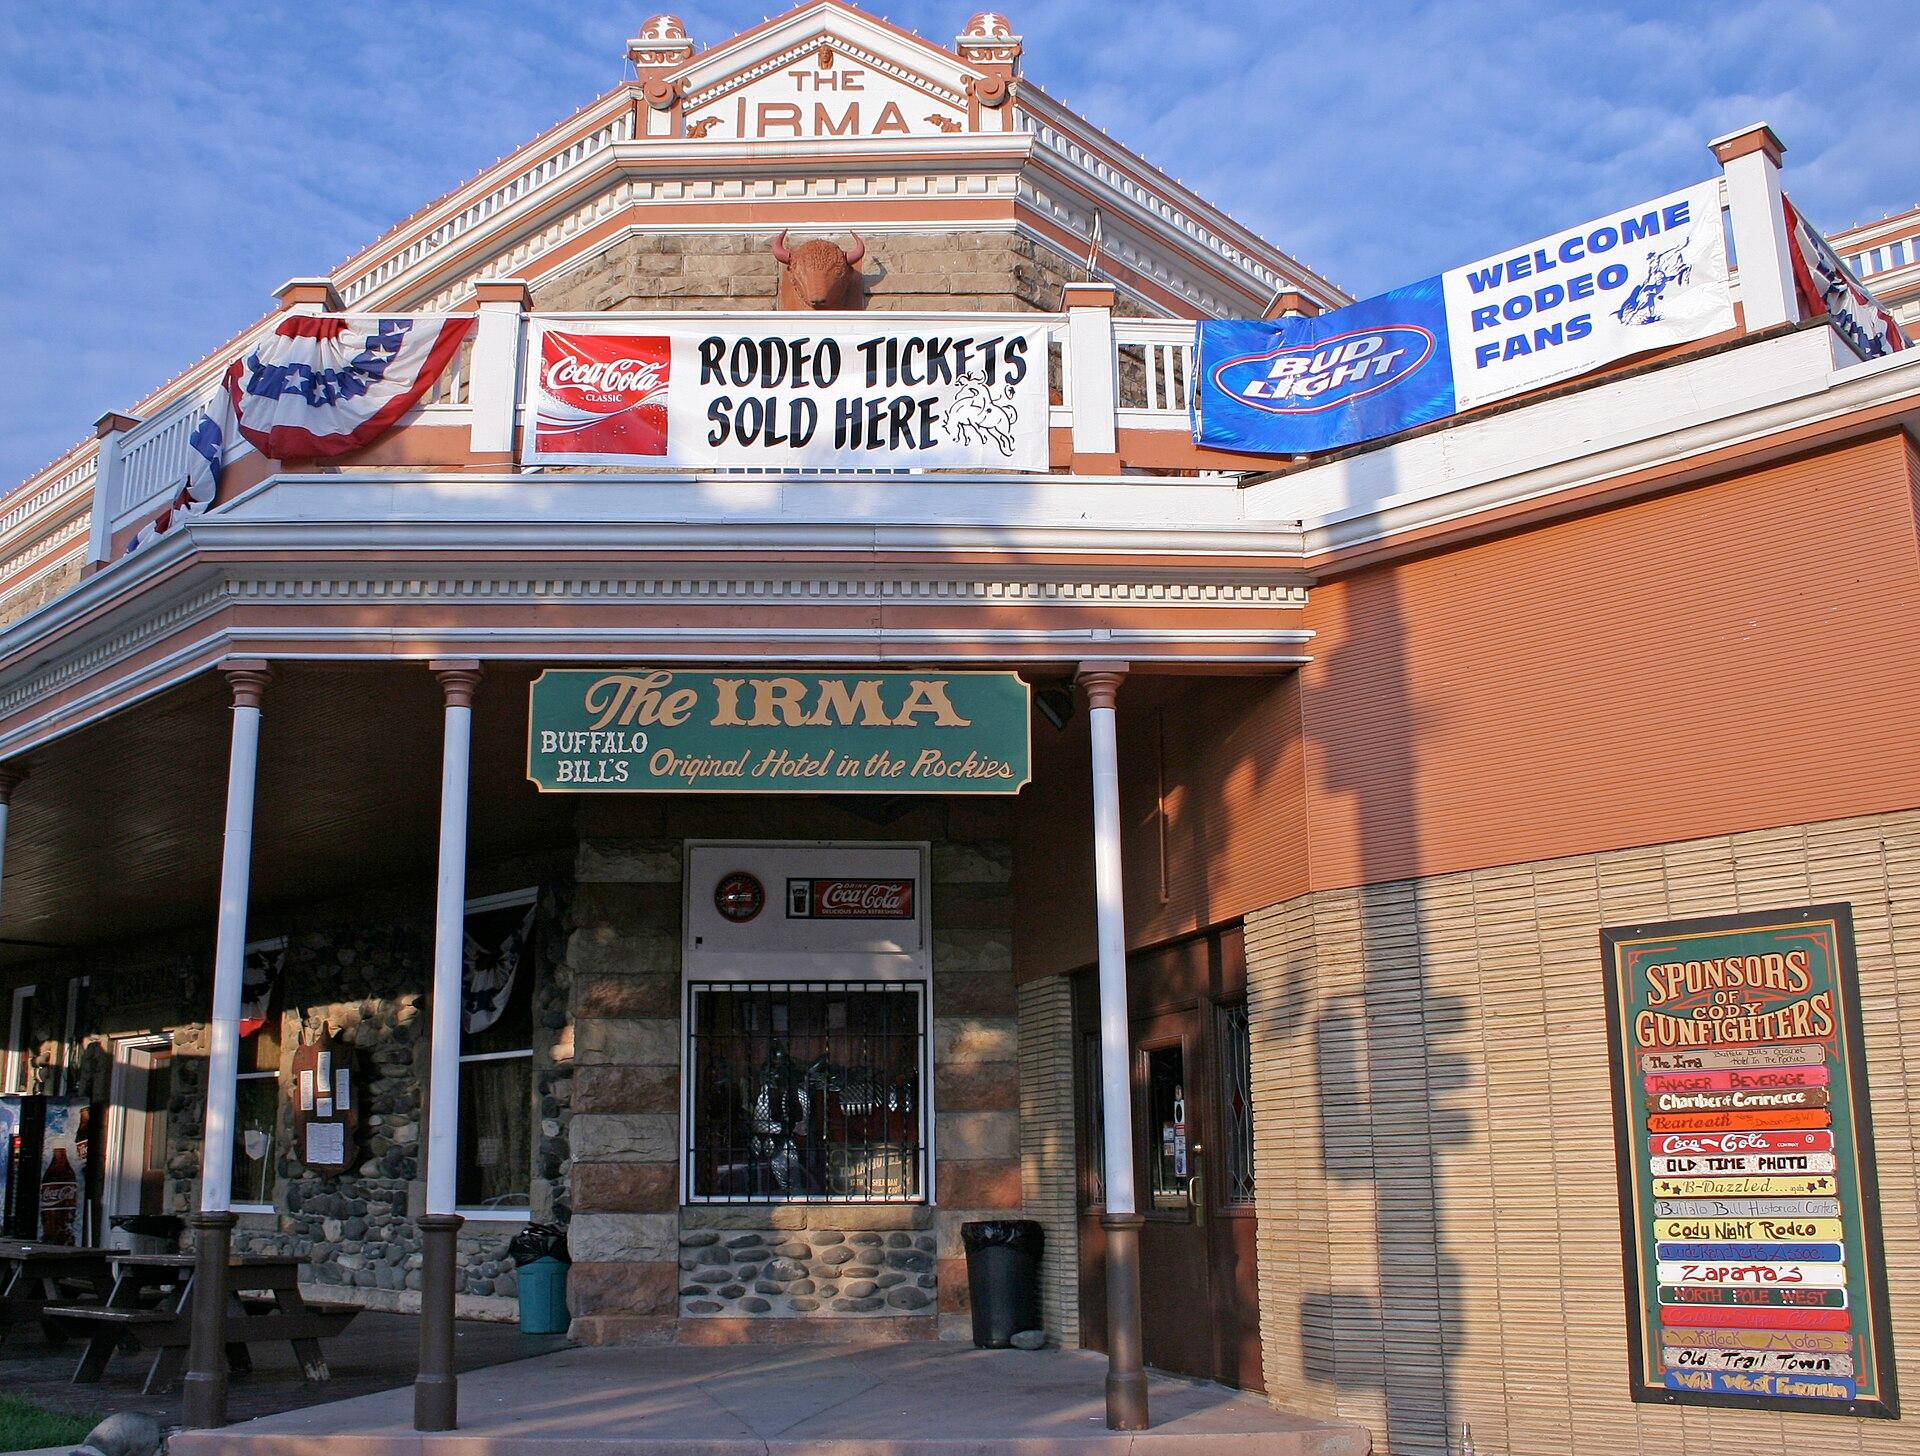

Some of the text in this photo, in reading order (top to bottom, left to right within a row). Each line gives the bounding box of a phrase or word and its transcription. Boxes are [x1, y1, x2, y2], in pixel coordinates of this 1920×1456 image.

[788, 70, 865, 91] THE
[737, 97, 910, 138] IRMA
[1466, 200, 1691, 295] WELCOME
[1471, 263, 1629, 333] RODEO
[1475, 313, 1593, 370] FANS
[699, 335, 1029, 388] RODEO TICKETS
[1267, 336, 1384, 379] BUD
[547, 355, 669, 393] Coca-Cola
[1242, 348, 1405, 400] LIGHT
[585, 393, 623, 403] CLASSIC
[707, 395, 940, 450] SOLD HERE
[585, 670, 972, 731] The IRMA
[541, 731, 649, 754] BUFFALO
[555, 758, 629, 784] BILL'S
[649, 748, 1016, 786] Original Hotel in the Rockies
[822, 883, 903, 909] Coca-Cola
[1646, 950, 1810, 1006] SPONSORS
[1714, 990, 1740, 1005] OF
[1634, 992, 1835, 1047] GUNFIGHTERS
[1692, 1002, 1762, 1020] CODY
[1650, 1055, 1703, 1069] The Irma
[1651, 1073, 1806, 1091] TANAGER BEVERAGE
[1659, 1092, 1806, 1110] Chamber of Commerce
[1666, 1156, 1808, 1172] OLD TIME PHOTO
[1659, 1200, 1838, 1216] Buffalo Bill Historical Center
[1668, 1222, 1817, 1240] Cody Night Rodeo
[1680, 1265, 1803, 1284] Zapata's
[1674, 1287, 1827, 1305] NORTH POLE WEST
[1764, 1333, 1834, 1349] Motors
[1678, 1350, 1831, 1370] Old Trail Town
[1672, 1371, 1713, 1390] Wild
[1720, 1374, 1775, 1394] West
